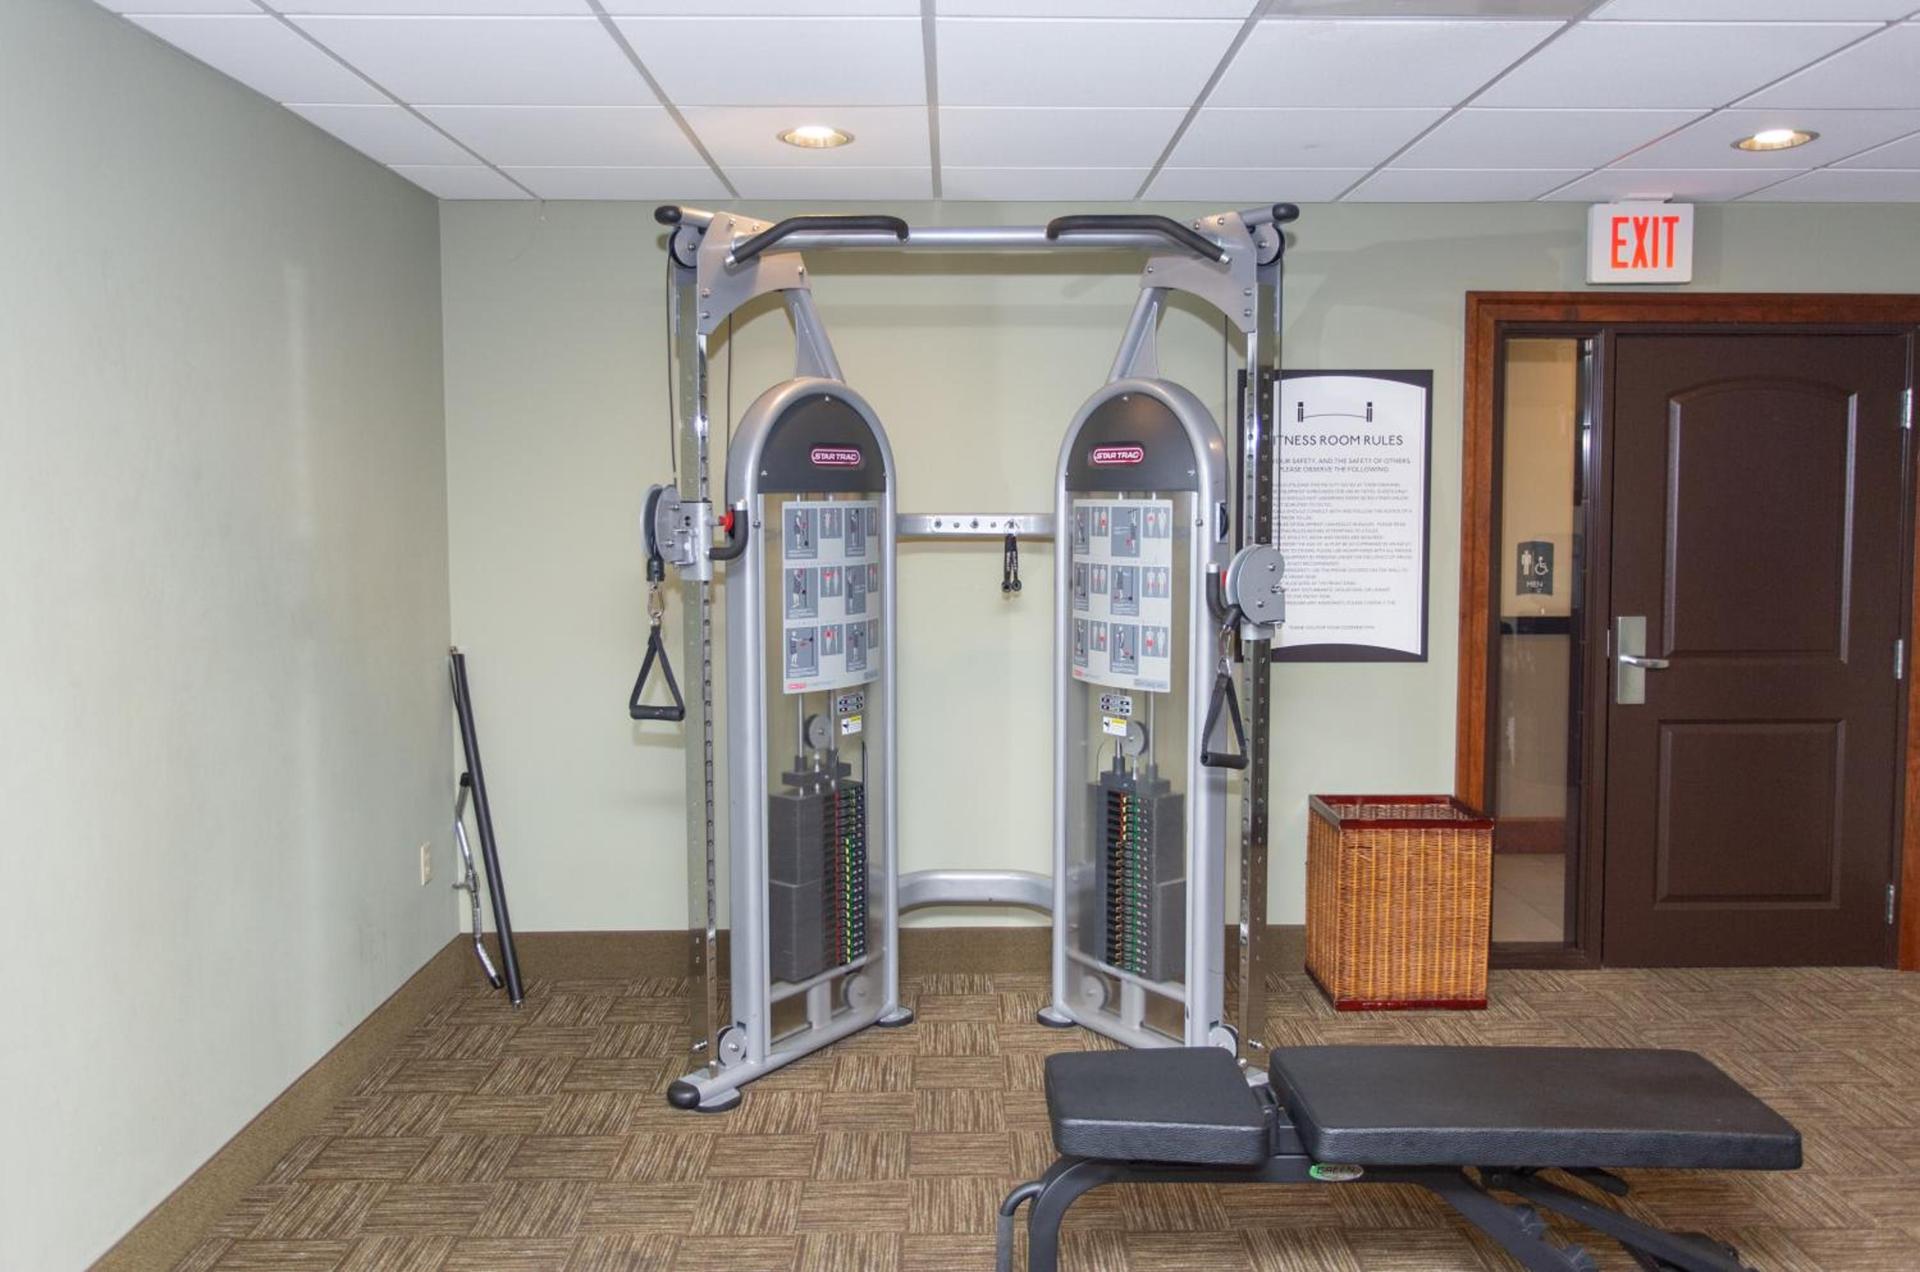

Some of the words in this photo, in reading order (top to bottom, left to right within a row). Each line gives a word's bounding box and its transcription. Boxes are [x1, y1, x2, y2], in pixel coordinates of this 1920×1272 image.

[1611, 216, 1680, 269] EXIT
[1318, 434, 1361, 446] ROOM
[1363, 434, 1404, 446] RULES
[814, 452, 835, 461] STAR
[836, 453, 857, 461] TRAC
[1096, 452, 1116, 460] STAR
[1117, 451, 1140, 459] TRAC
[1318, 456, 1333, 465] AND
[1334, 456, 1347, 465] THE
[1348, 456, 1372, 465] SAFETY
[1334, 465, 1347, 474] THE
